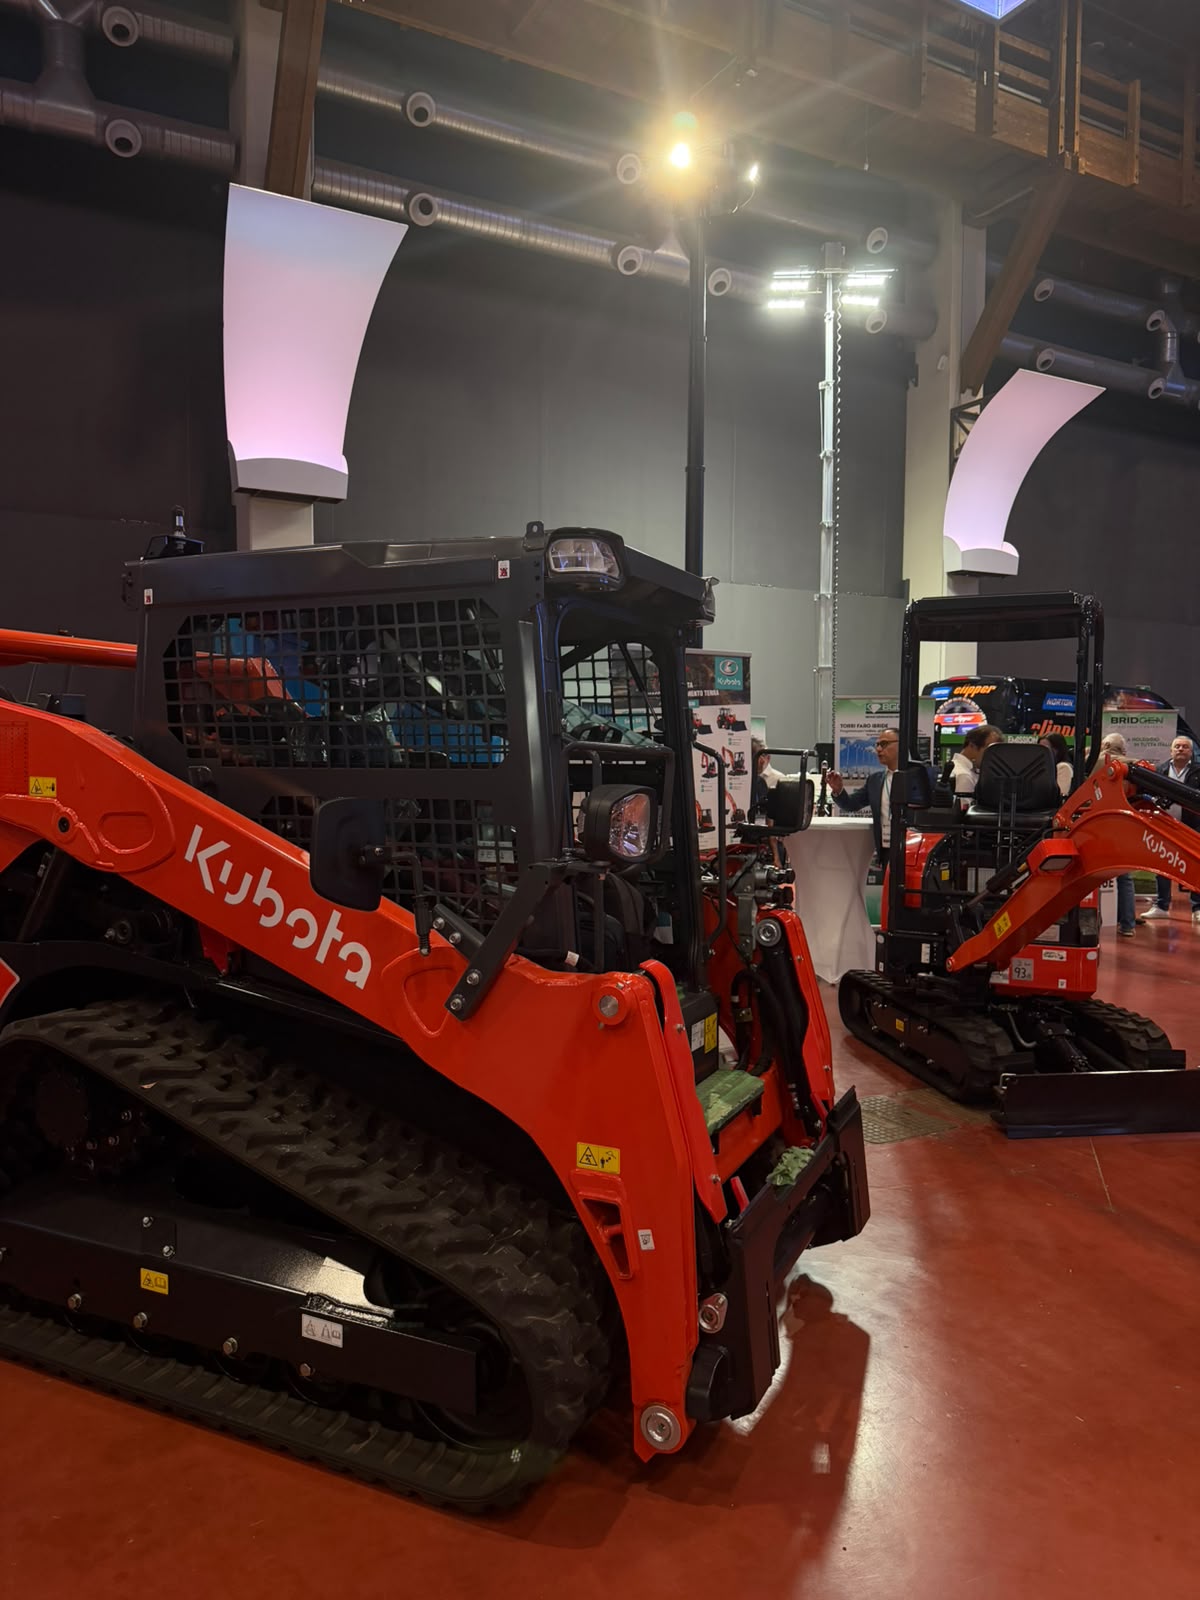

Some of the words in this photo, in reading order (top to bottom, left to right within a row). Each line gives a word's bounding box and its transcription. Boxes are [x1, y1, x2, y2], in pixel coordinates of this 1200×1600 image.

[717, 677, 741, 686] Kubota
[953, 684, 997, 698] clipper
[1046, 698, 1073, 707] NORTON
[1110, 716, 1164, 724] BRIDGEN
[1142, 829, 1187, 874] Kubota
[184, 823, 372, 990] Kubota
[1014, 966, 1027, 979] 93
